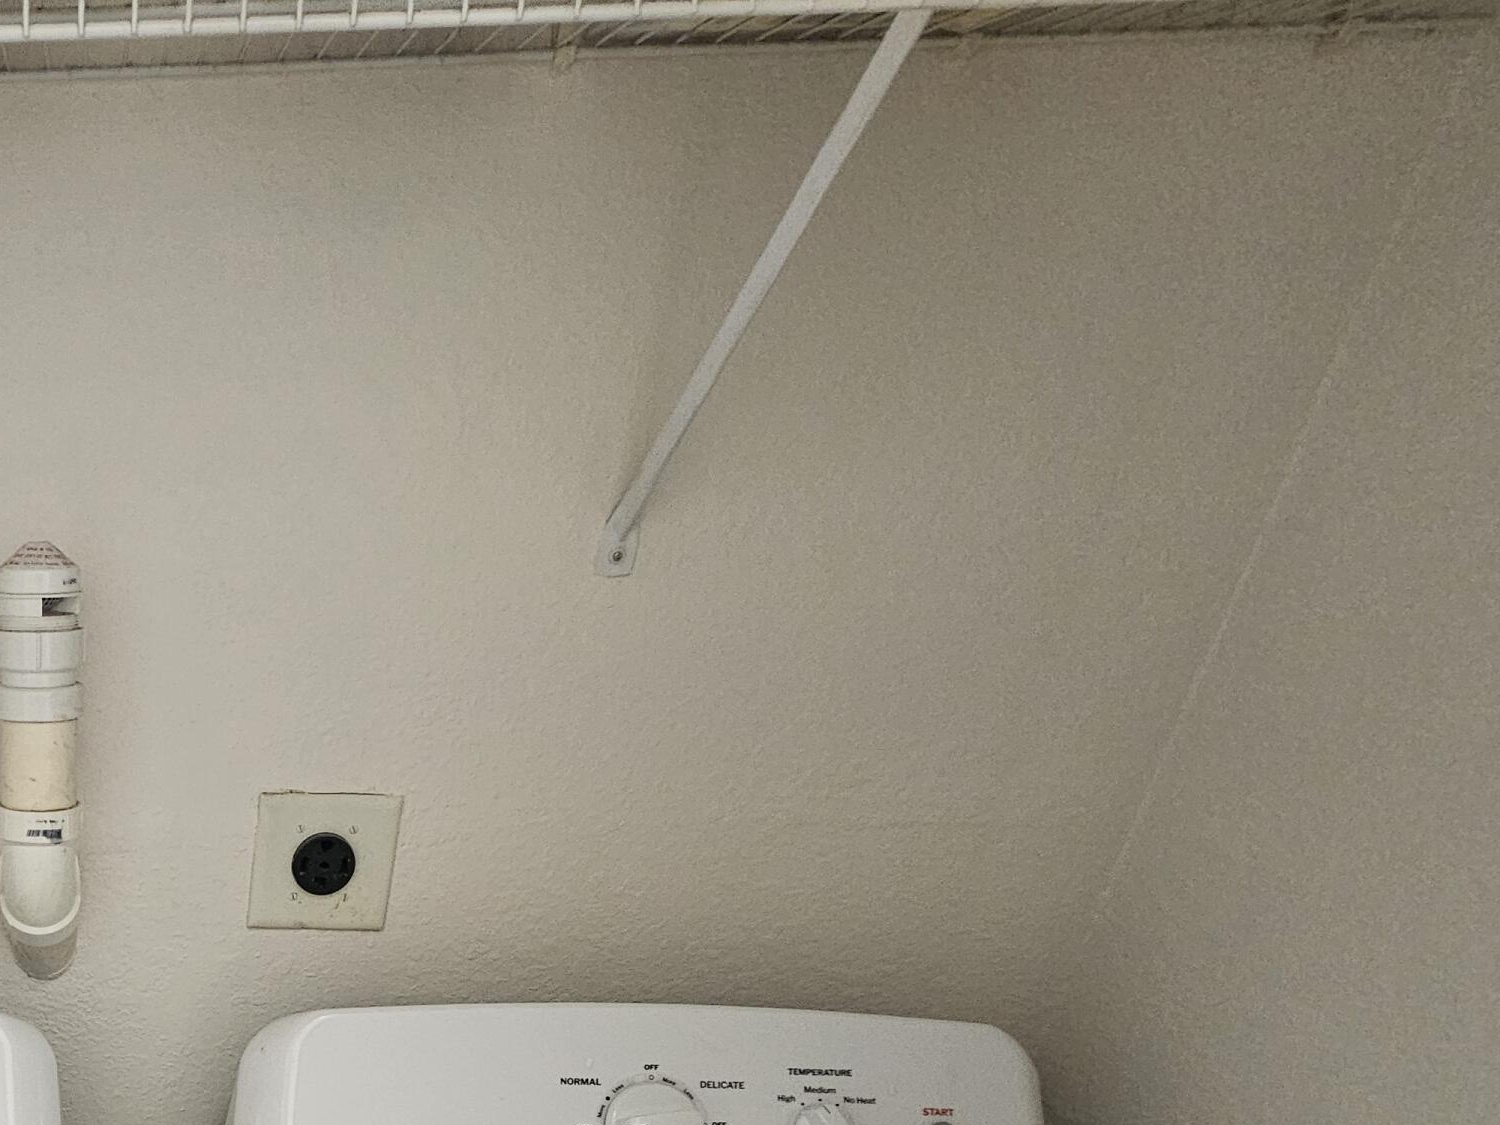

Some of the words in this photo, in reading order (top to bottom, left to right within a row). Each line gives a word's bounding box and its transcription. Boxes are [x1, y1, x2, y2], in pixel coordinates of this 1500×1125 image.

[788, 1068, 853, 1077] TEMPERATURE
[560, 1077, 601, 1086] NORMAL
[700, 1081, 745, 1090] DELICATE
[803, 1086, 837, 1094] Medium
[777, 1094, 796, 1103] High
[843, 1096, 855, 1104] No
[857, 1097, 876, 1105] Heat
[922, 1107, 954, 1116] START
